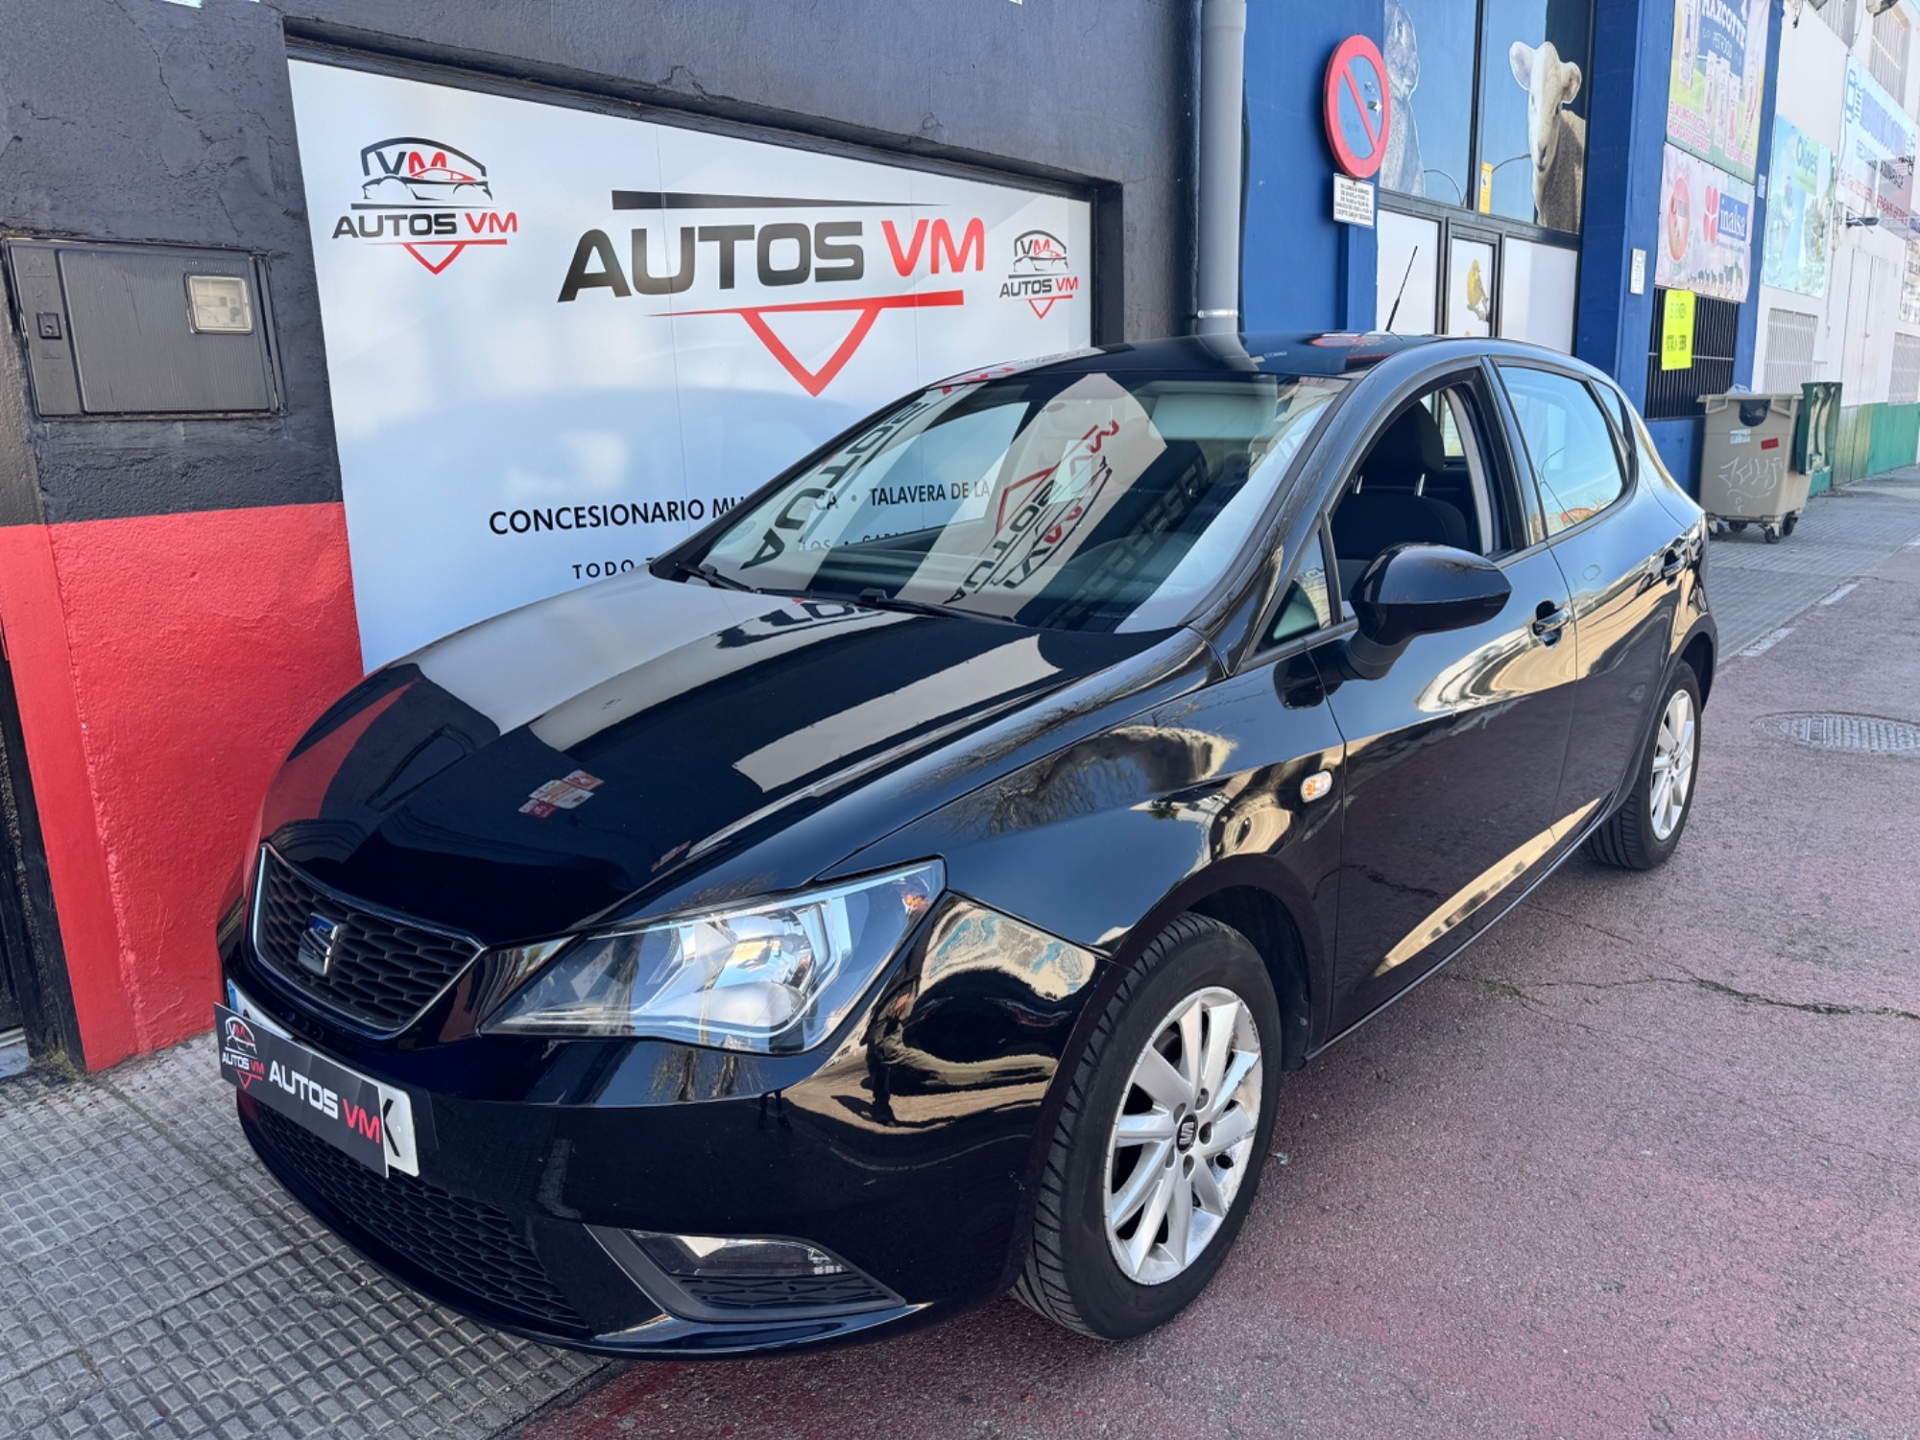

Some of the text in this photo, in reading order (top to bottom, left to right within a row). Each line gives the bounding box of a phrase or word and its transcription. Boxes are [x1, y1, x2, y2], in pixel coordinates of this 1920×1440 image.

[375, 151, 447, 177] VM
[331, 211, 518, 239] AUTOS VM
[556, 217, 985, 303] AUTOS VM
[999, 276, 1078, 298] AUTOS VM
[489, 498, 705, 535] CONCESIONARIO
[870, 483, 946, 507] TALAVERA
[951, 481, 969, 499] DE
[973, 479, 991, 498] LA
[572, 559, 634, 580] TODO
[221, 1052, 265, 1075] AUTOS VM
[269, 1060, 381, 1144] AUTOS VM
